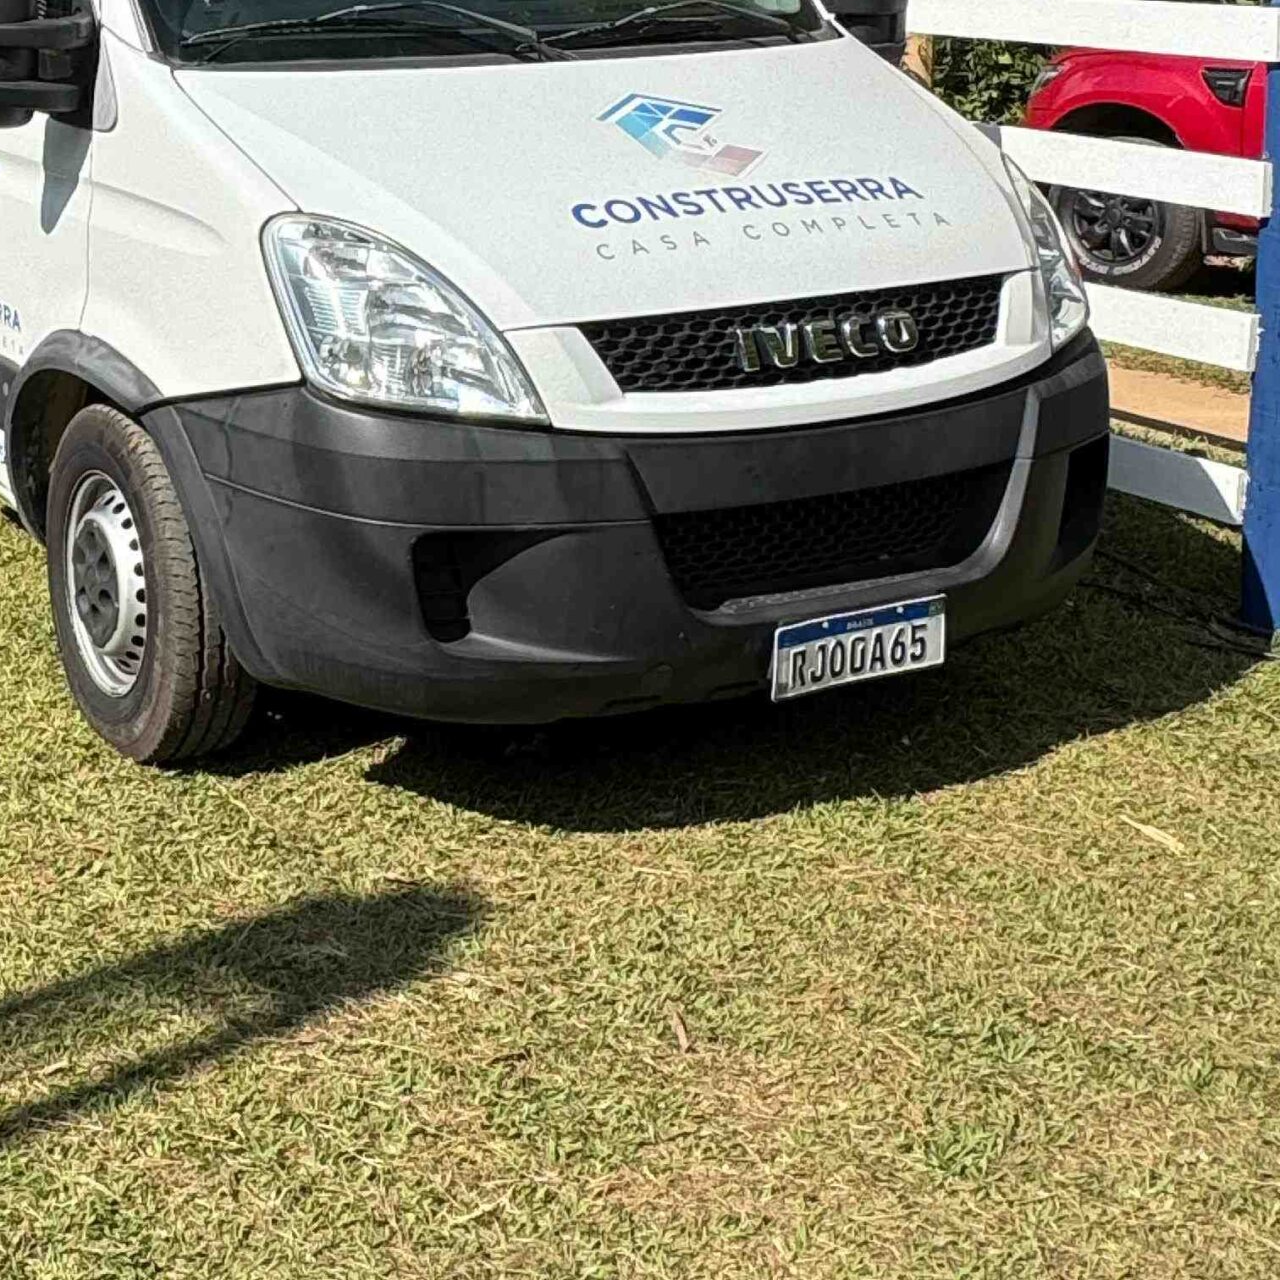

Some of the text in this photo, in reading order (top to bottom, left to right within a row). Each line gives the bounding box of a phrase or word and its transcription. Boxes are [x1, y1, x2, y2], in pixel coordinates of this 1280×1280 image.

[571, 176, 923, 229] CONSTRUSERRA
[596, 211, 953, 261] CASA COMPLETA
[734, 309, 920, 373] IVECO
